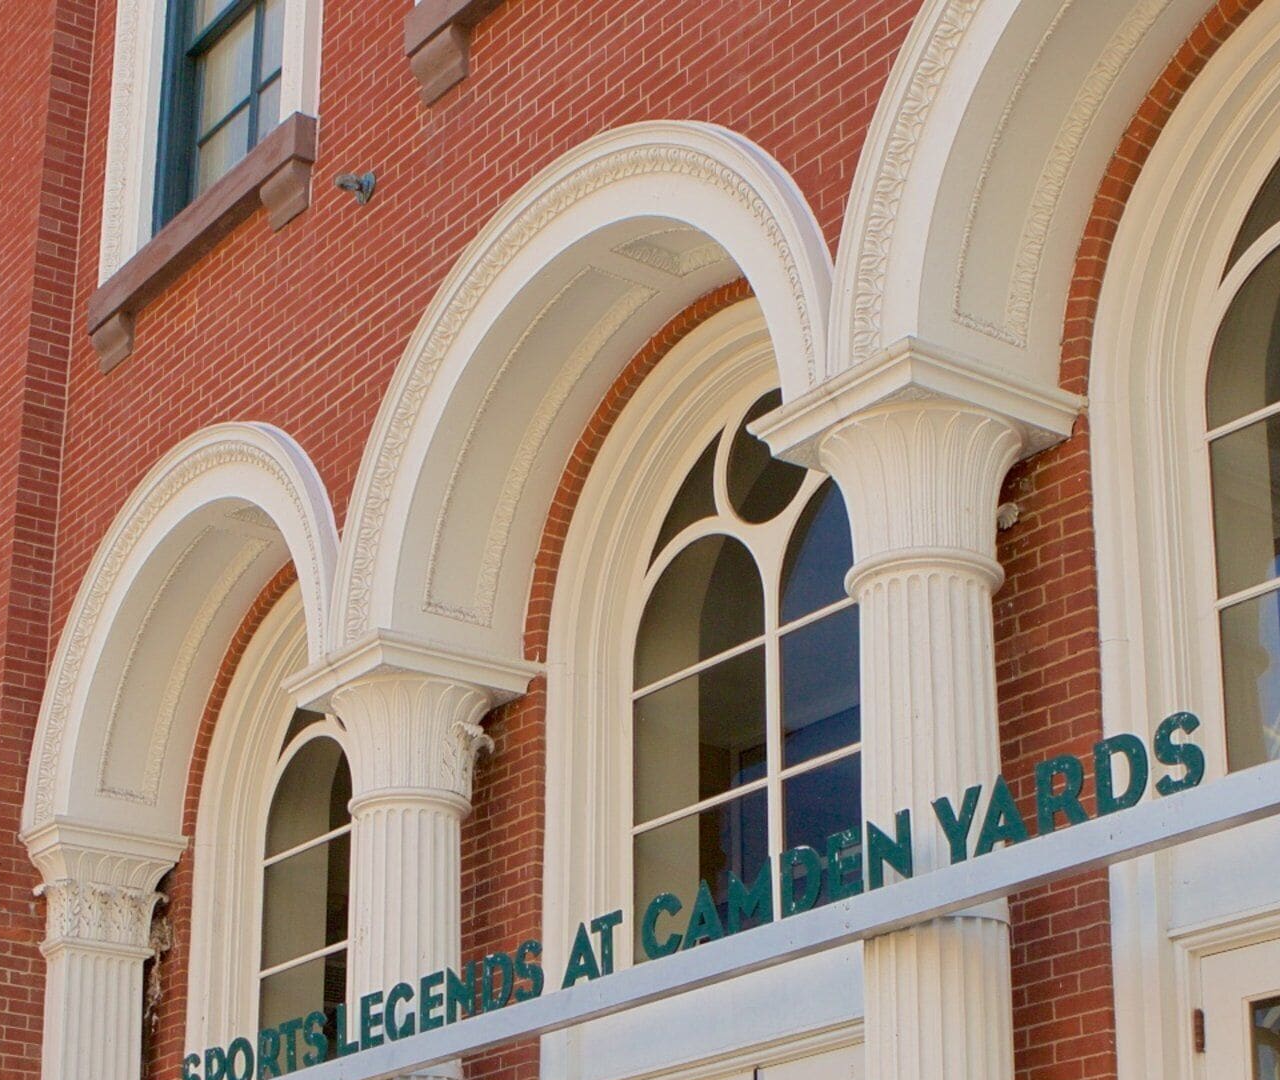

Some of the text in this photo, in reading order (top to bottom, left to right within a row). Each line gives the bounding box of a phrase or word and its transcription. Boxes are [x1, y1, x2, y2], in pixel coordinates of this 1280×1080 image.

[336, 940, 544, 1056] LEGENDS
[561, 909, 622, 989] AT
[641, 809, 912, 961] CAMDEN
[933, 711, 1205, 864] YARDS
